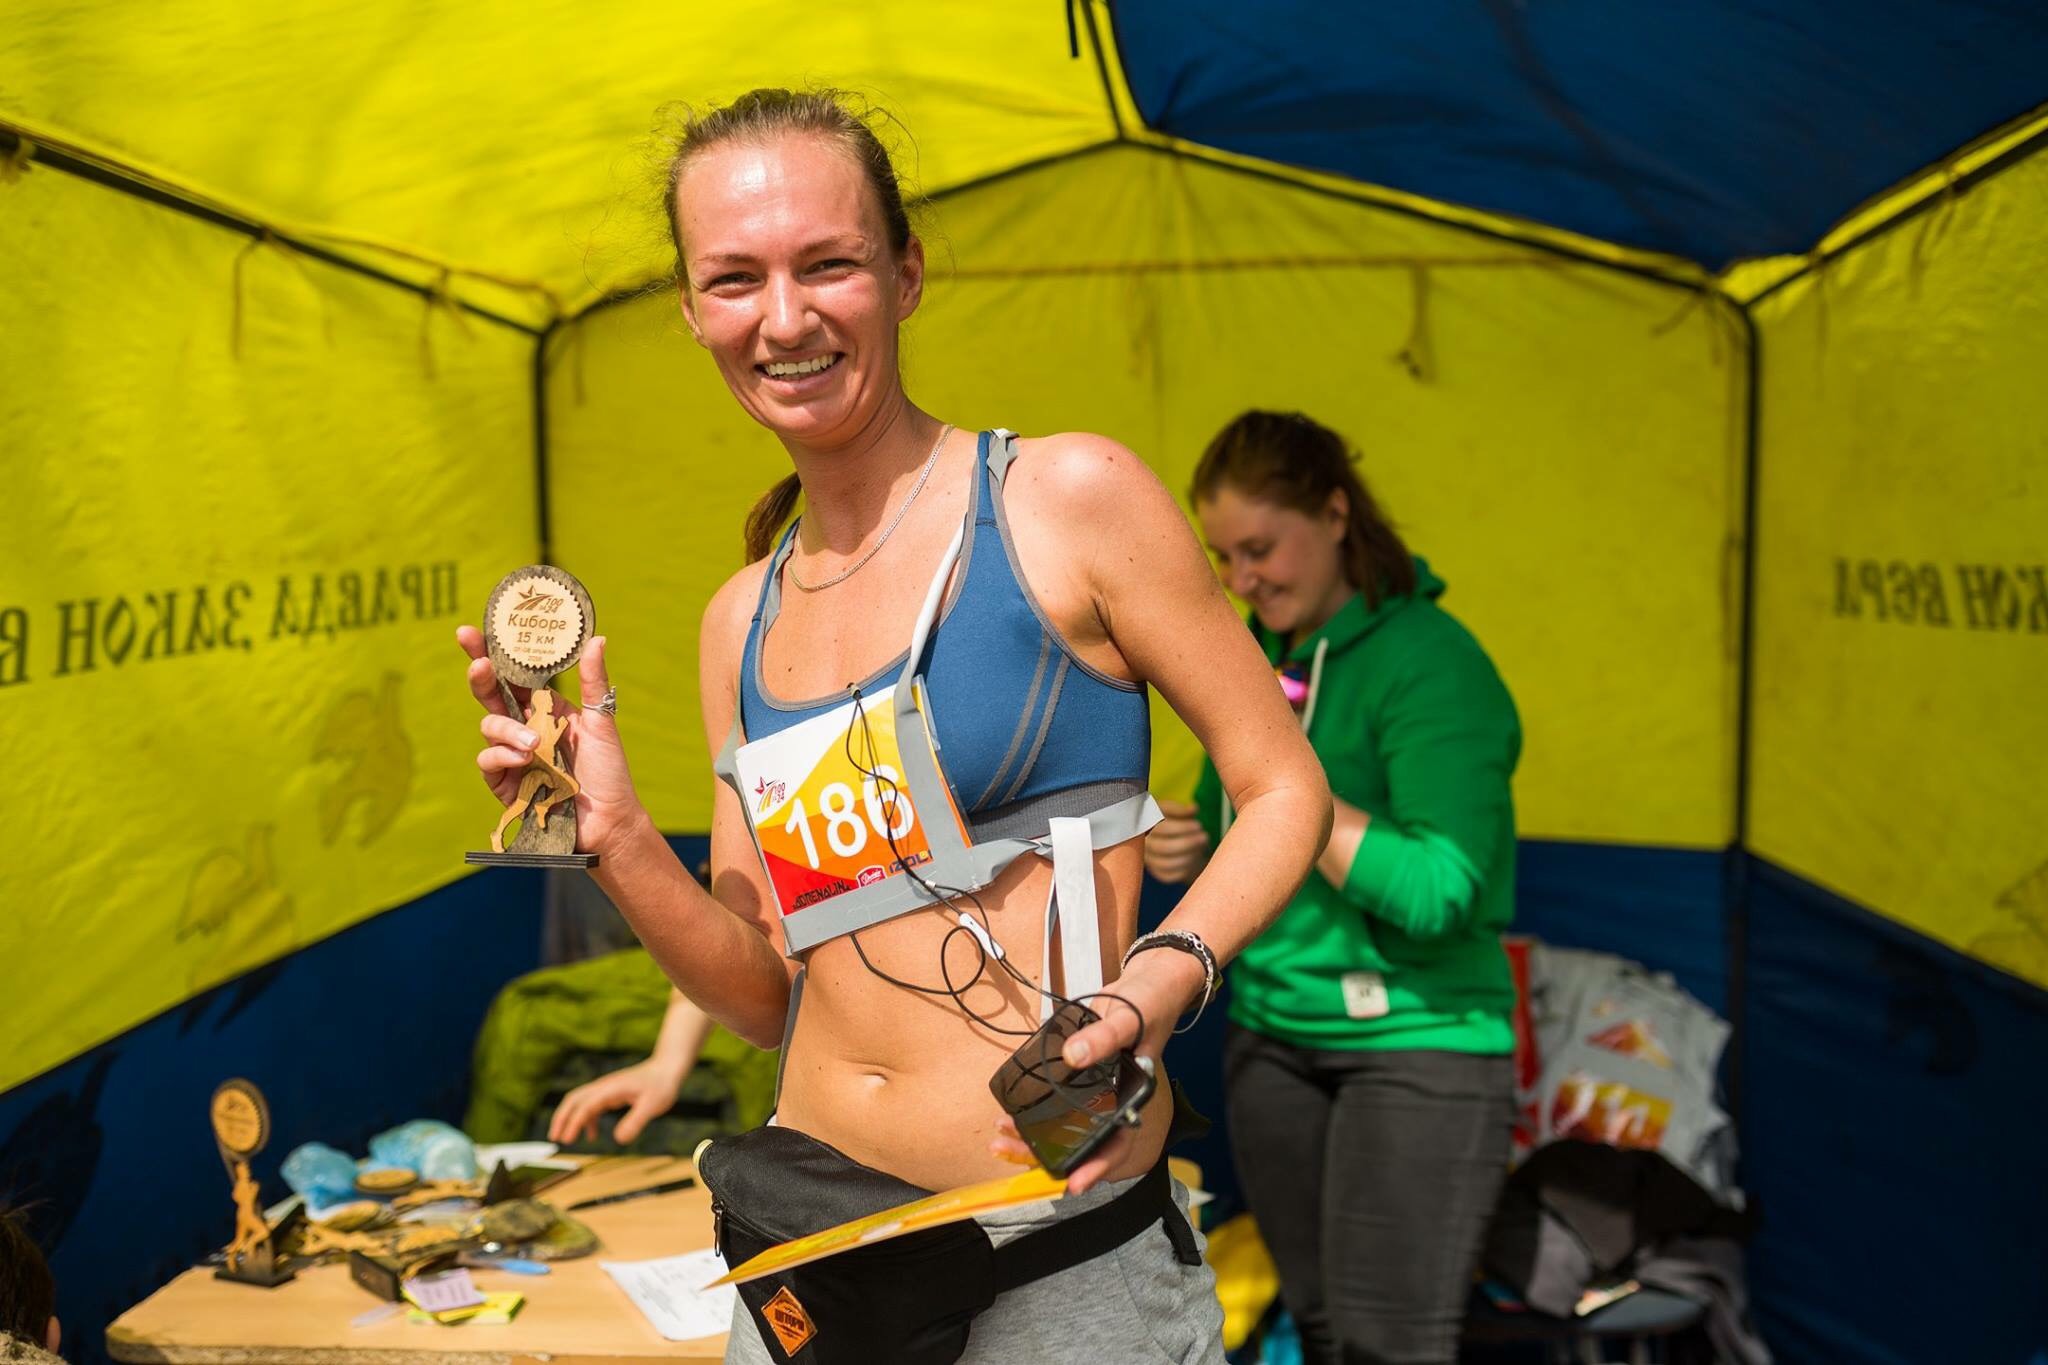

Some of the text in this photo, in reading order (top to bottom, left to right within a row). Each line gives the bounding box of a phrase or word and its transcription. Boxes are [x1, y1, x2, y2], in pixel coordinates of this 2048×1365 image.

[508, 613, 567, 632] Киборг
[517, 631, 532, 643] 15
[785, 765, 915, 869] 186
